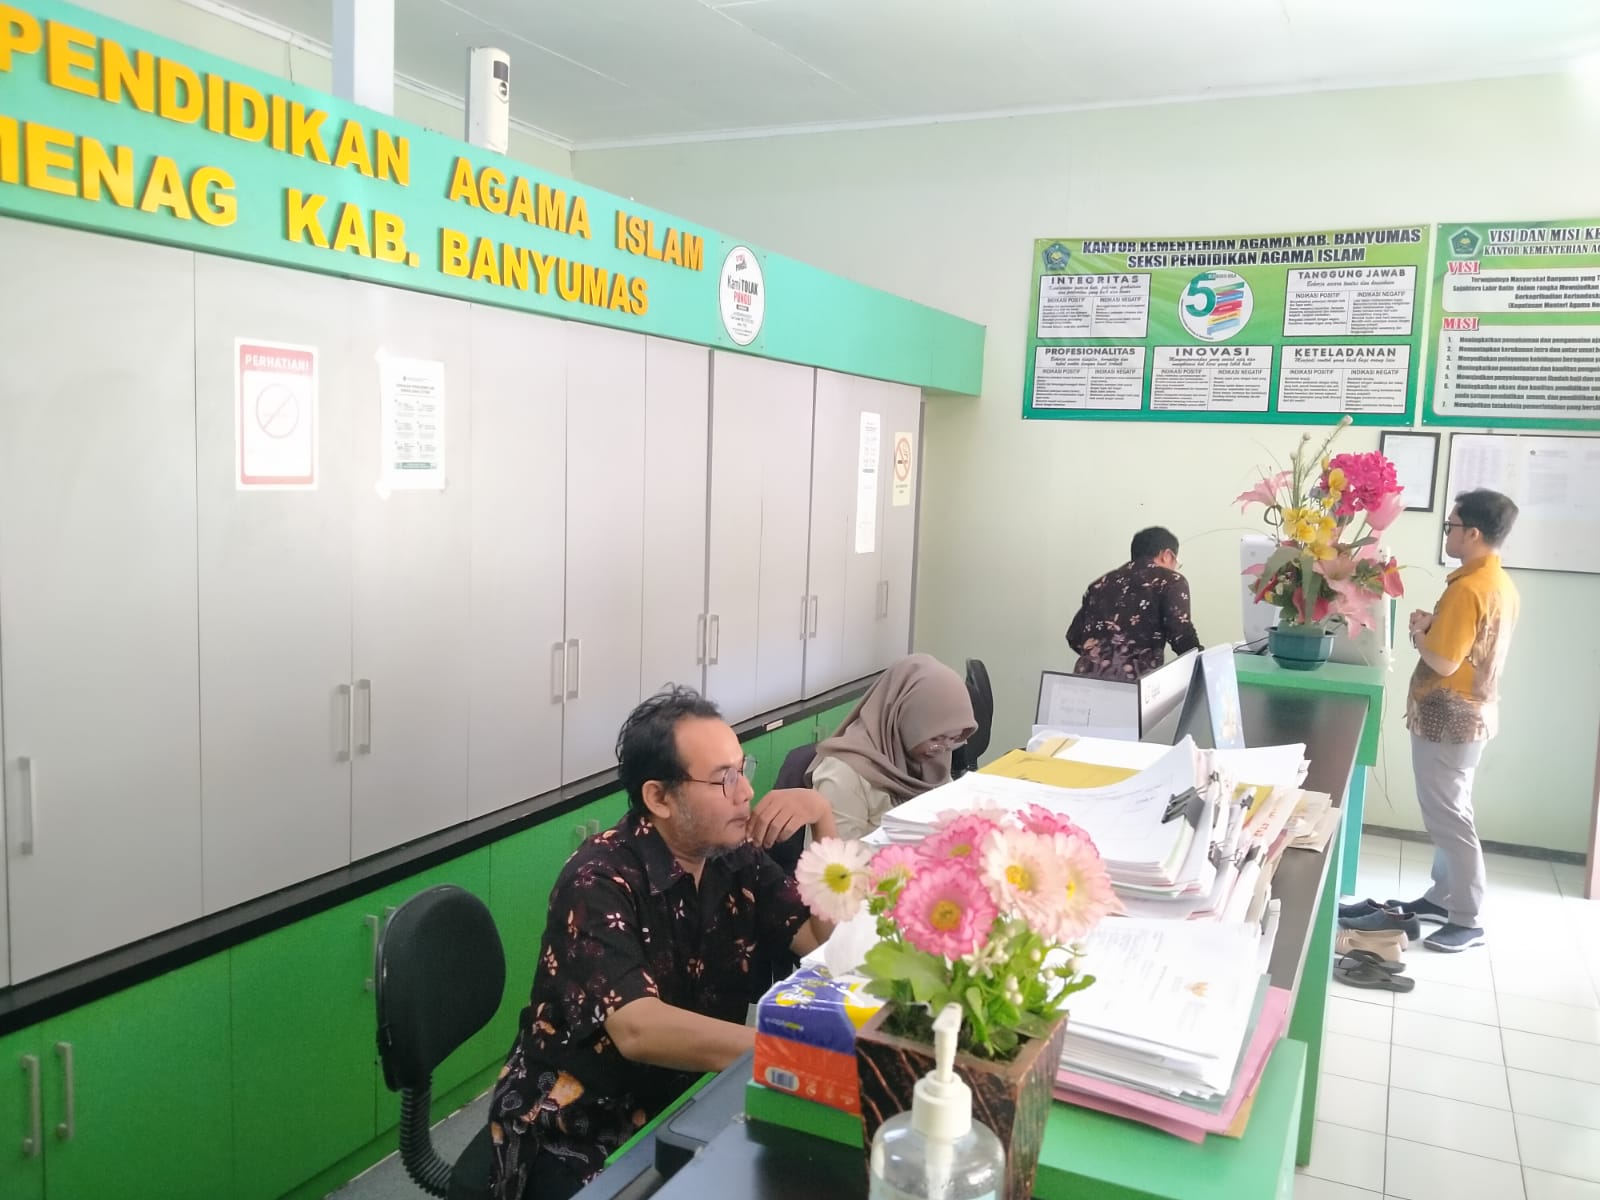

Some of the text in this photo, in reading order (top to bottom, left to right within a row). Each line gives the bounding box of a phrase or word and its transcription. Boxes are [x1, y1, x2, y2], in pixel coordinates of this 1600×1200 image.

[0, 4, 704, 272] PENDIDIKAN AGAMA ISLAM
[1082, 229, 1421, 254] KANTOR KEMENTERIAN AGAMA KAB. BANYUMAS
[1489, 230, 1515, 243] VISI
[1519, 229, 1546, 242] DAN
[1550, 228, 1580, 241] MISI
[286, 188, 419, 267] KAB.
[440, 228, 648, 316] BANYUMAS
[1484, 245, 1520, 256] KANTOR
[1523, 244, 1588, 255] KEMENTERIAN
[1128, 248, 1365, 268] SEKSI PENDIDIKAN AGAMA ISLAM
[1298, 269, 1406, 279] TANGGUNG JAWAB
[1448, 262, 1480, 275] VISI
[1051, 275, 1139, 285] INTEGRITAS
[741, 279, 758, 296] TOLAK
[1443, 318, 1478, 331] MISI
[1045, 347, 1136, 356] PROFESIONALITAS
[1175, 347, 1249, 356] INOVASI
[1295, 347, 1397, 357] KETELADANAN
